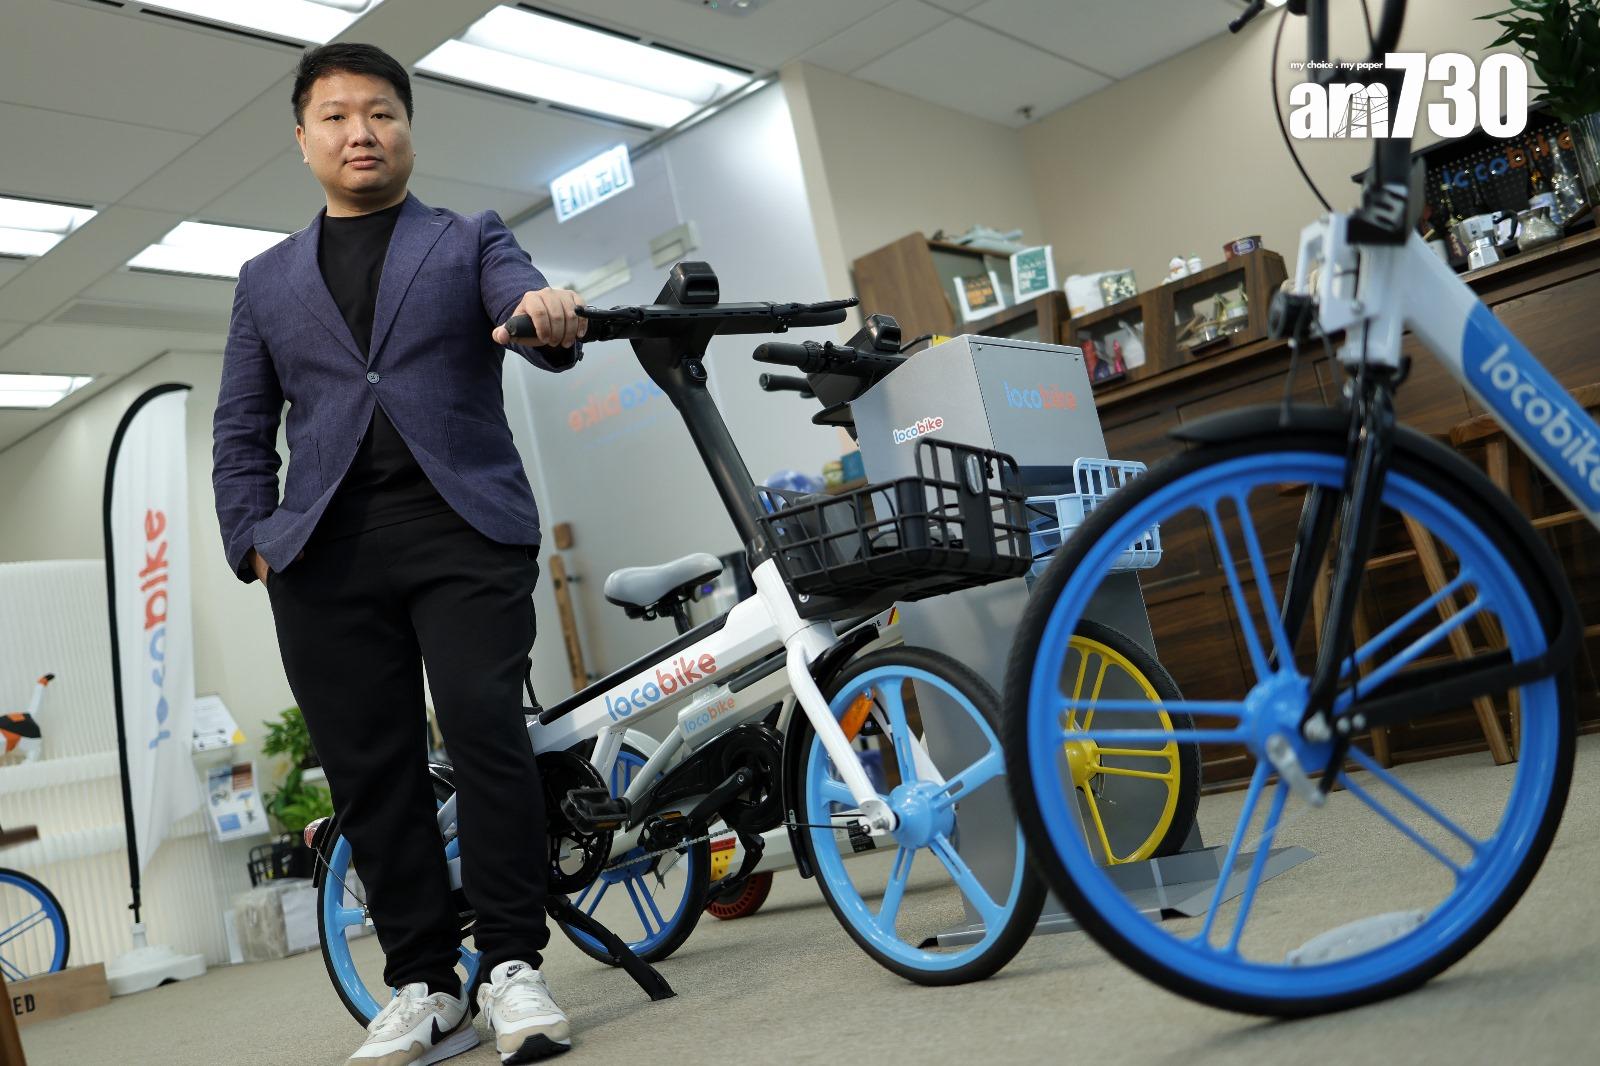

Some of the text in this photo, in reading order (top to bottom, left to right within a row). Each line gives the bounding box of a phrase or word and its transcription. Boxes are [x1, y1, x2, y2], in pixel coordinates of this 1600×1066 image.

[1003, 382, 1077, 411] locobike
[894, 417, 943, 443] locobike
[604, 653, 718, 722] locobike
[683, 696, 737, 734] locobike
[508, 963, 524, 971] NIKE
